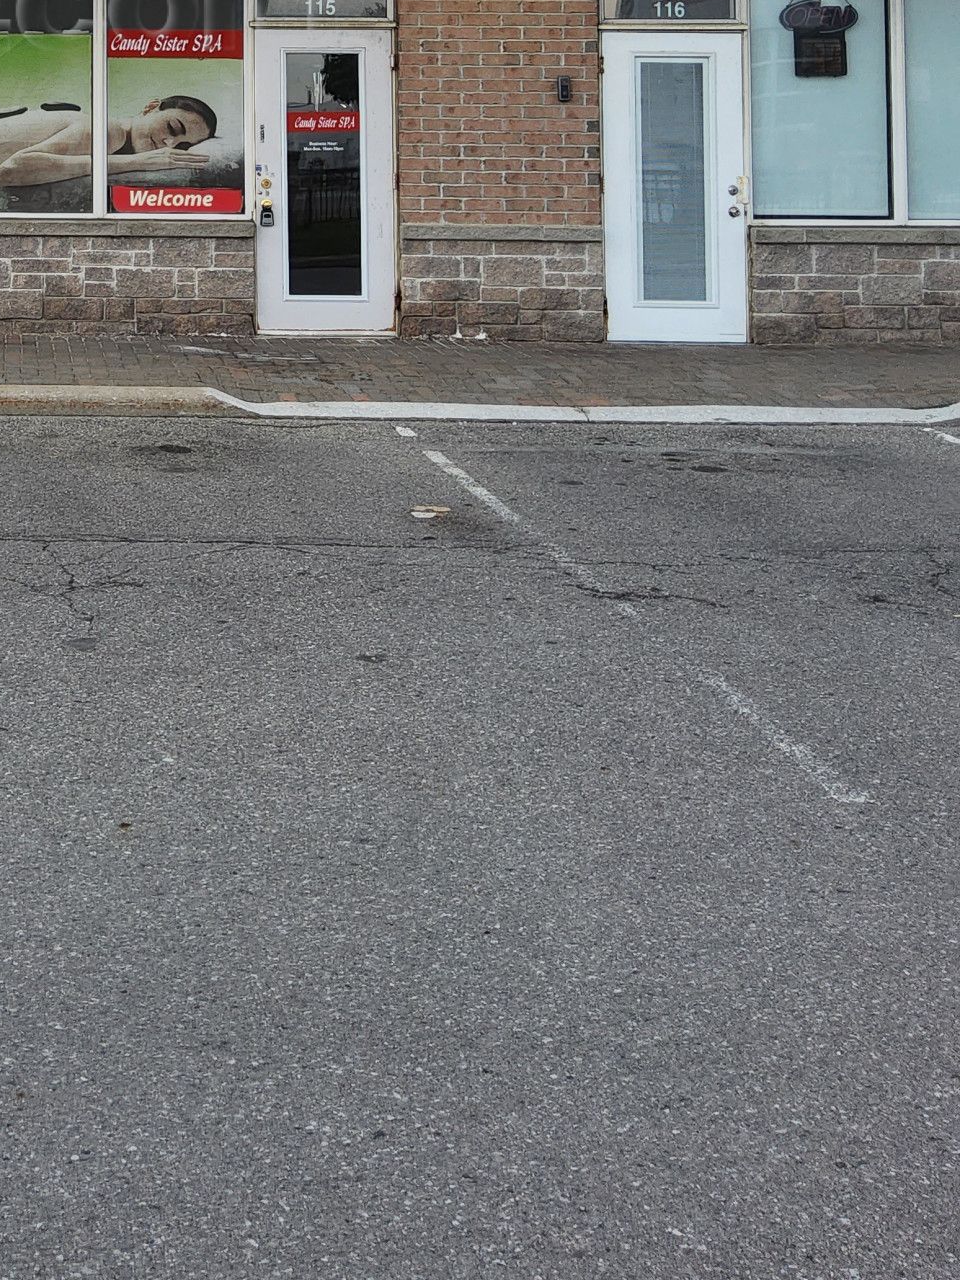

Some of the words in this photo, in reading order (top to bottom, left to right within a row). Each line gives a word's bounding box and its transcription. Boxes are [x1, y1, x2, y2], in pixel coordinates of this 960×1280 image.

[305, 0, 337, 16] 115
[653, 1, 686, 18] 116
[789, 6, 851, 27] OPEN
[110, 33, 150, 55] Candy
[154, 34, 189, 52] Sister
[192, 34, 222, 52] SPA
[294, 116, 317, 131] Candy
[318, 116, 338, 128] Sister
[338, 116, 355, 129] SPA
[129, 189, 214, 207] Welcome
